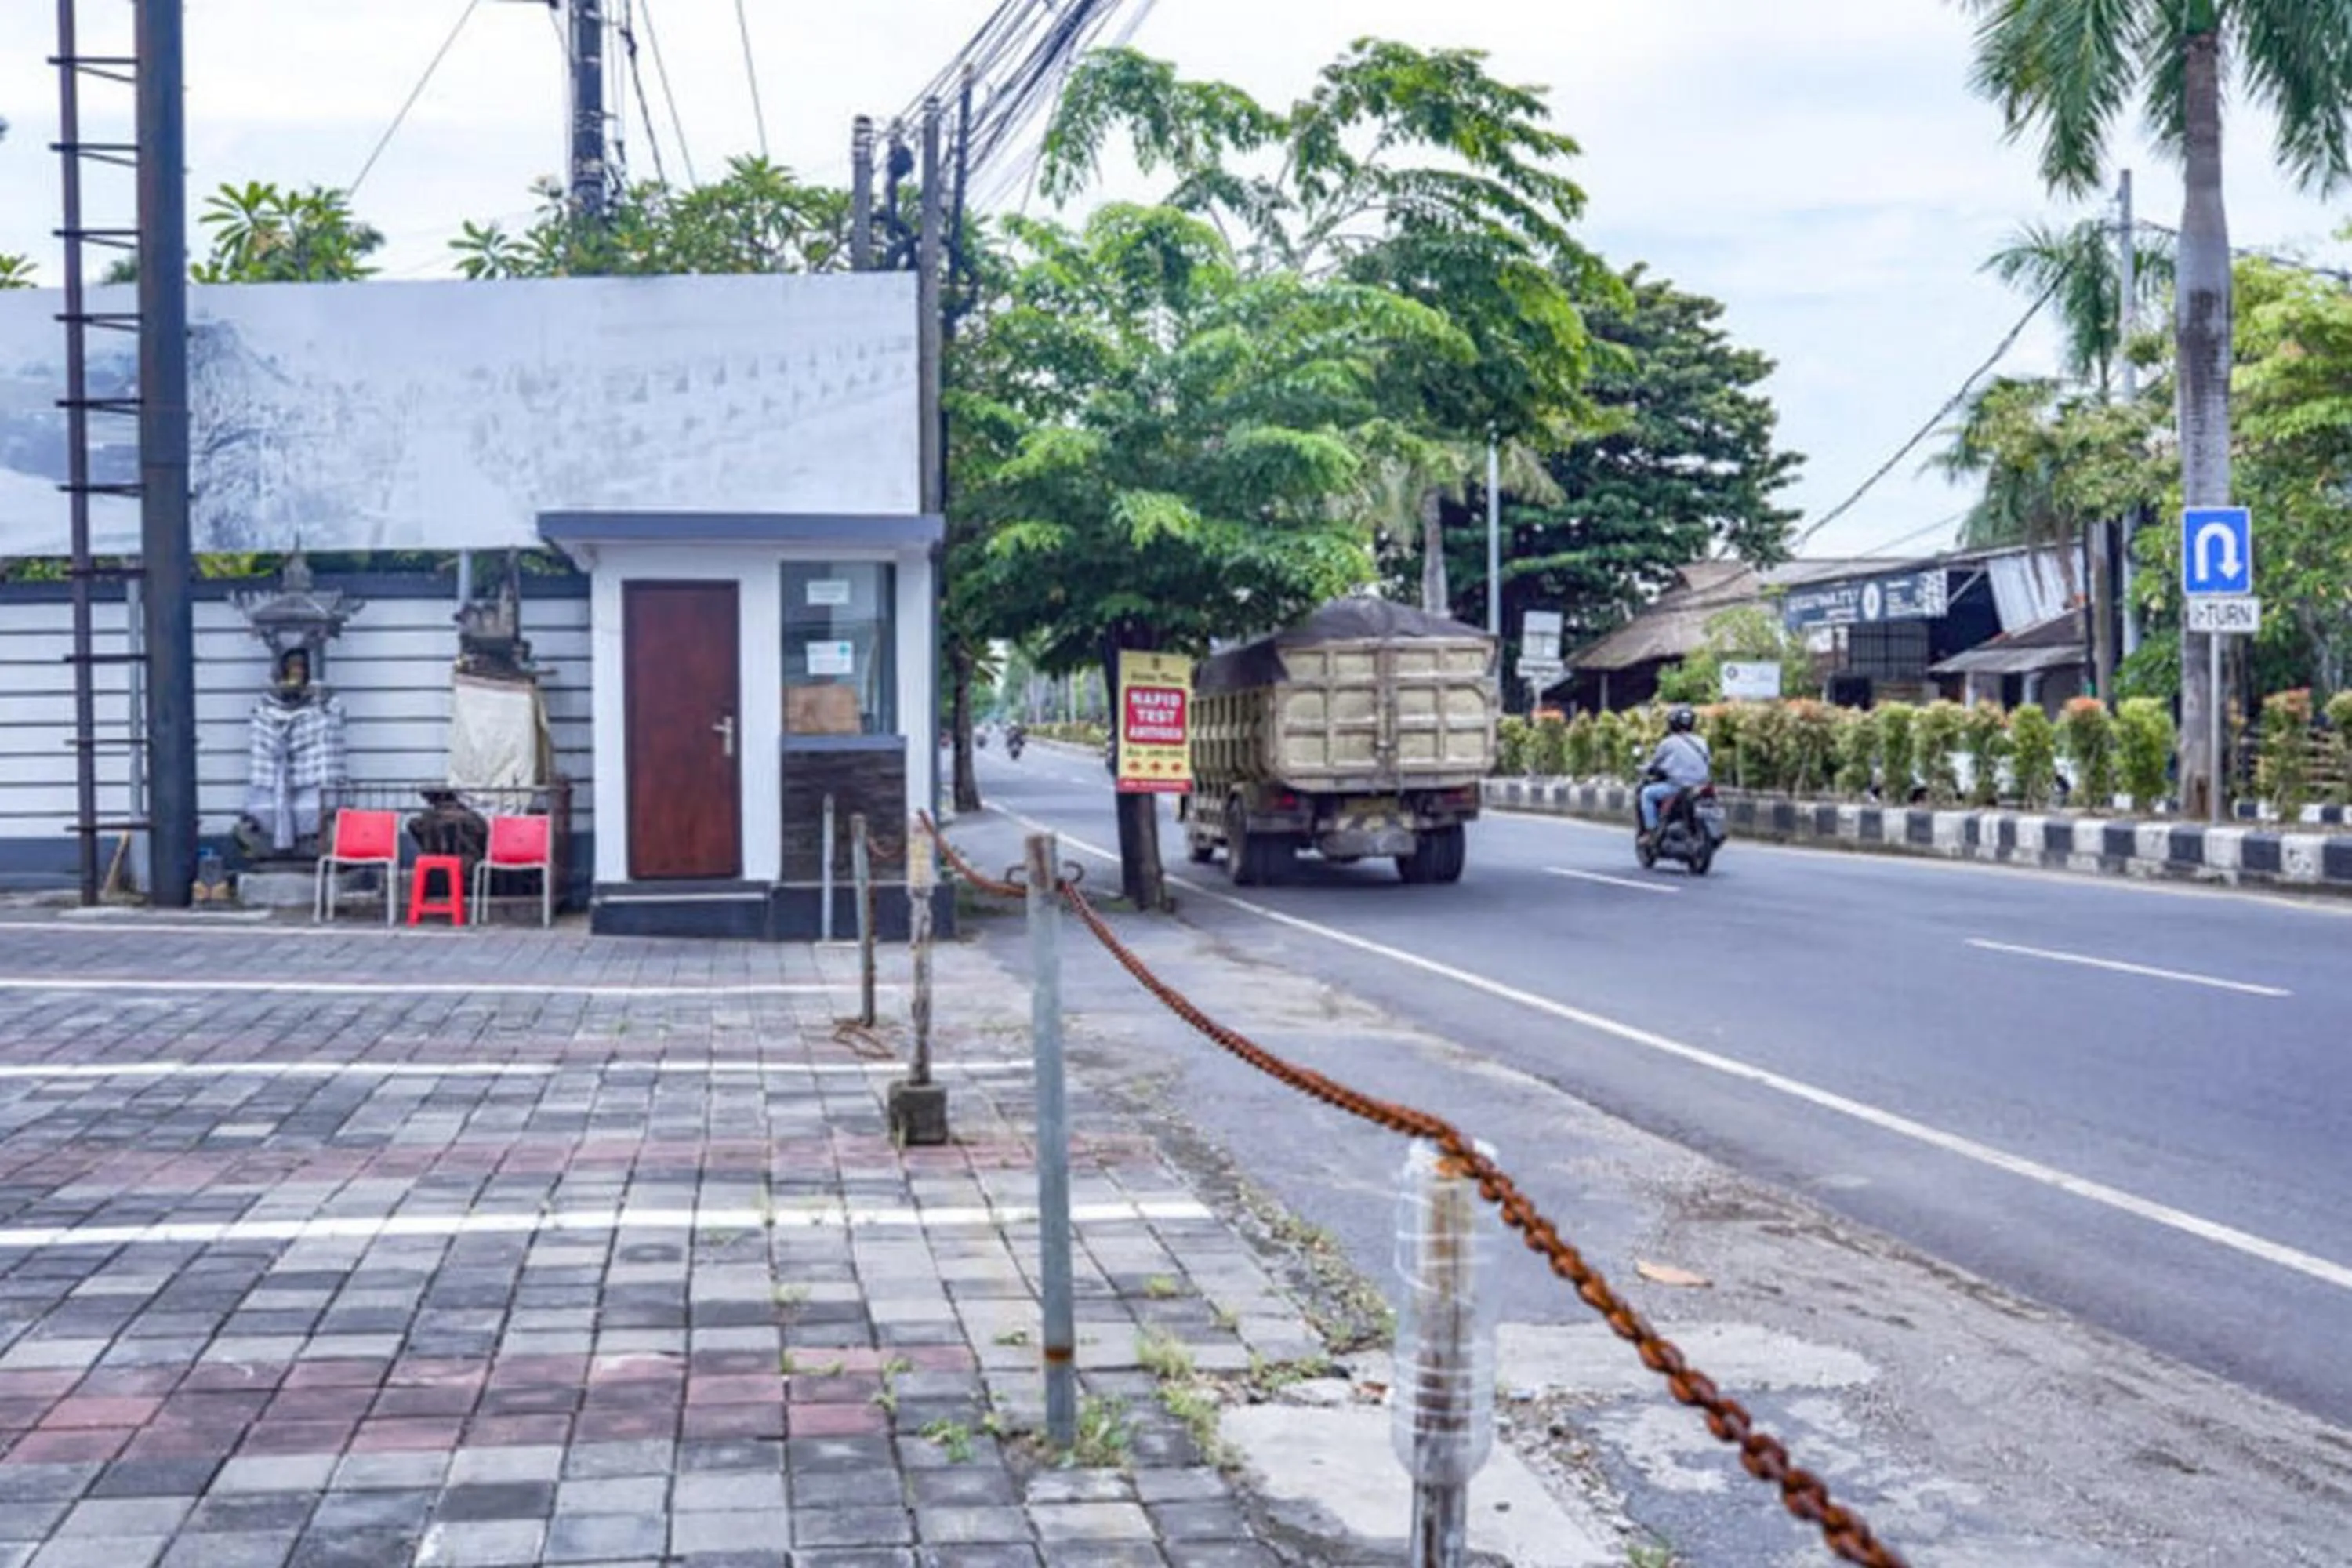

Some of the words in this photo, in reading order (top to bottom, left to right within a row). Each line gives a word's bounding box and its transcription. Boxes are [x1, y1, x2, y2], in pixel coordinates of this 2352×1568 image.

[2191, 602, 2253, 626] -TURN
[1131, 691, 1181, 707] RAPID
[1135, 708, 1175, 723] TEST
